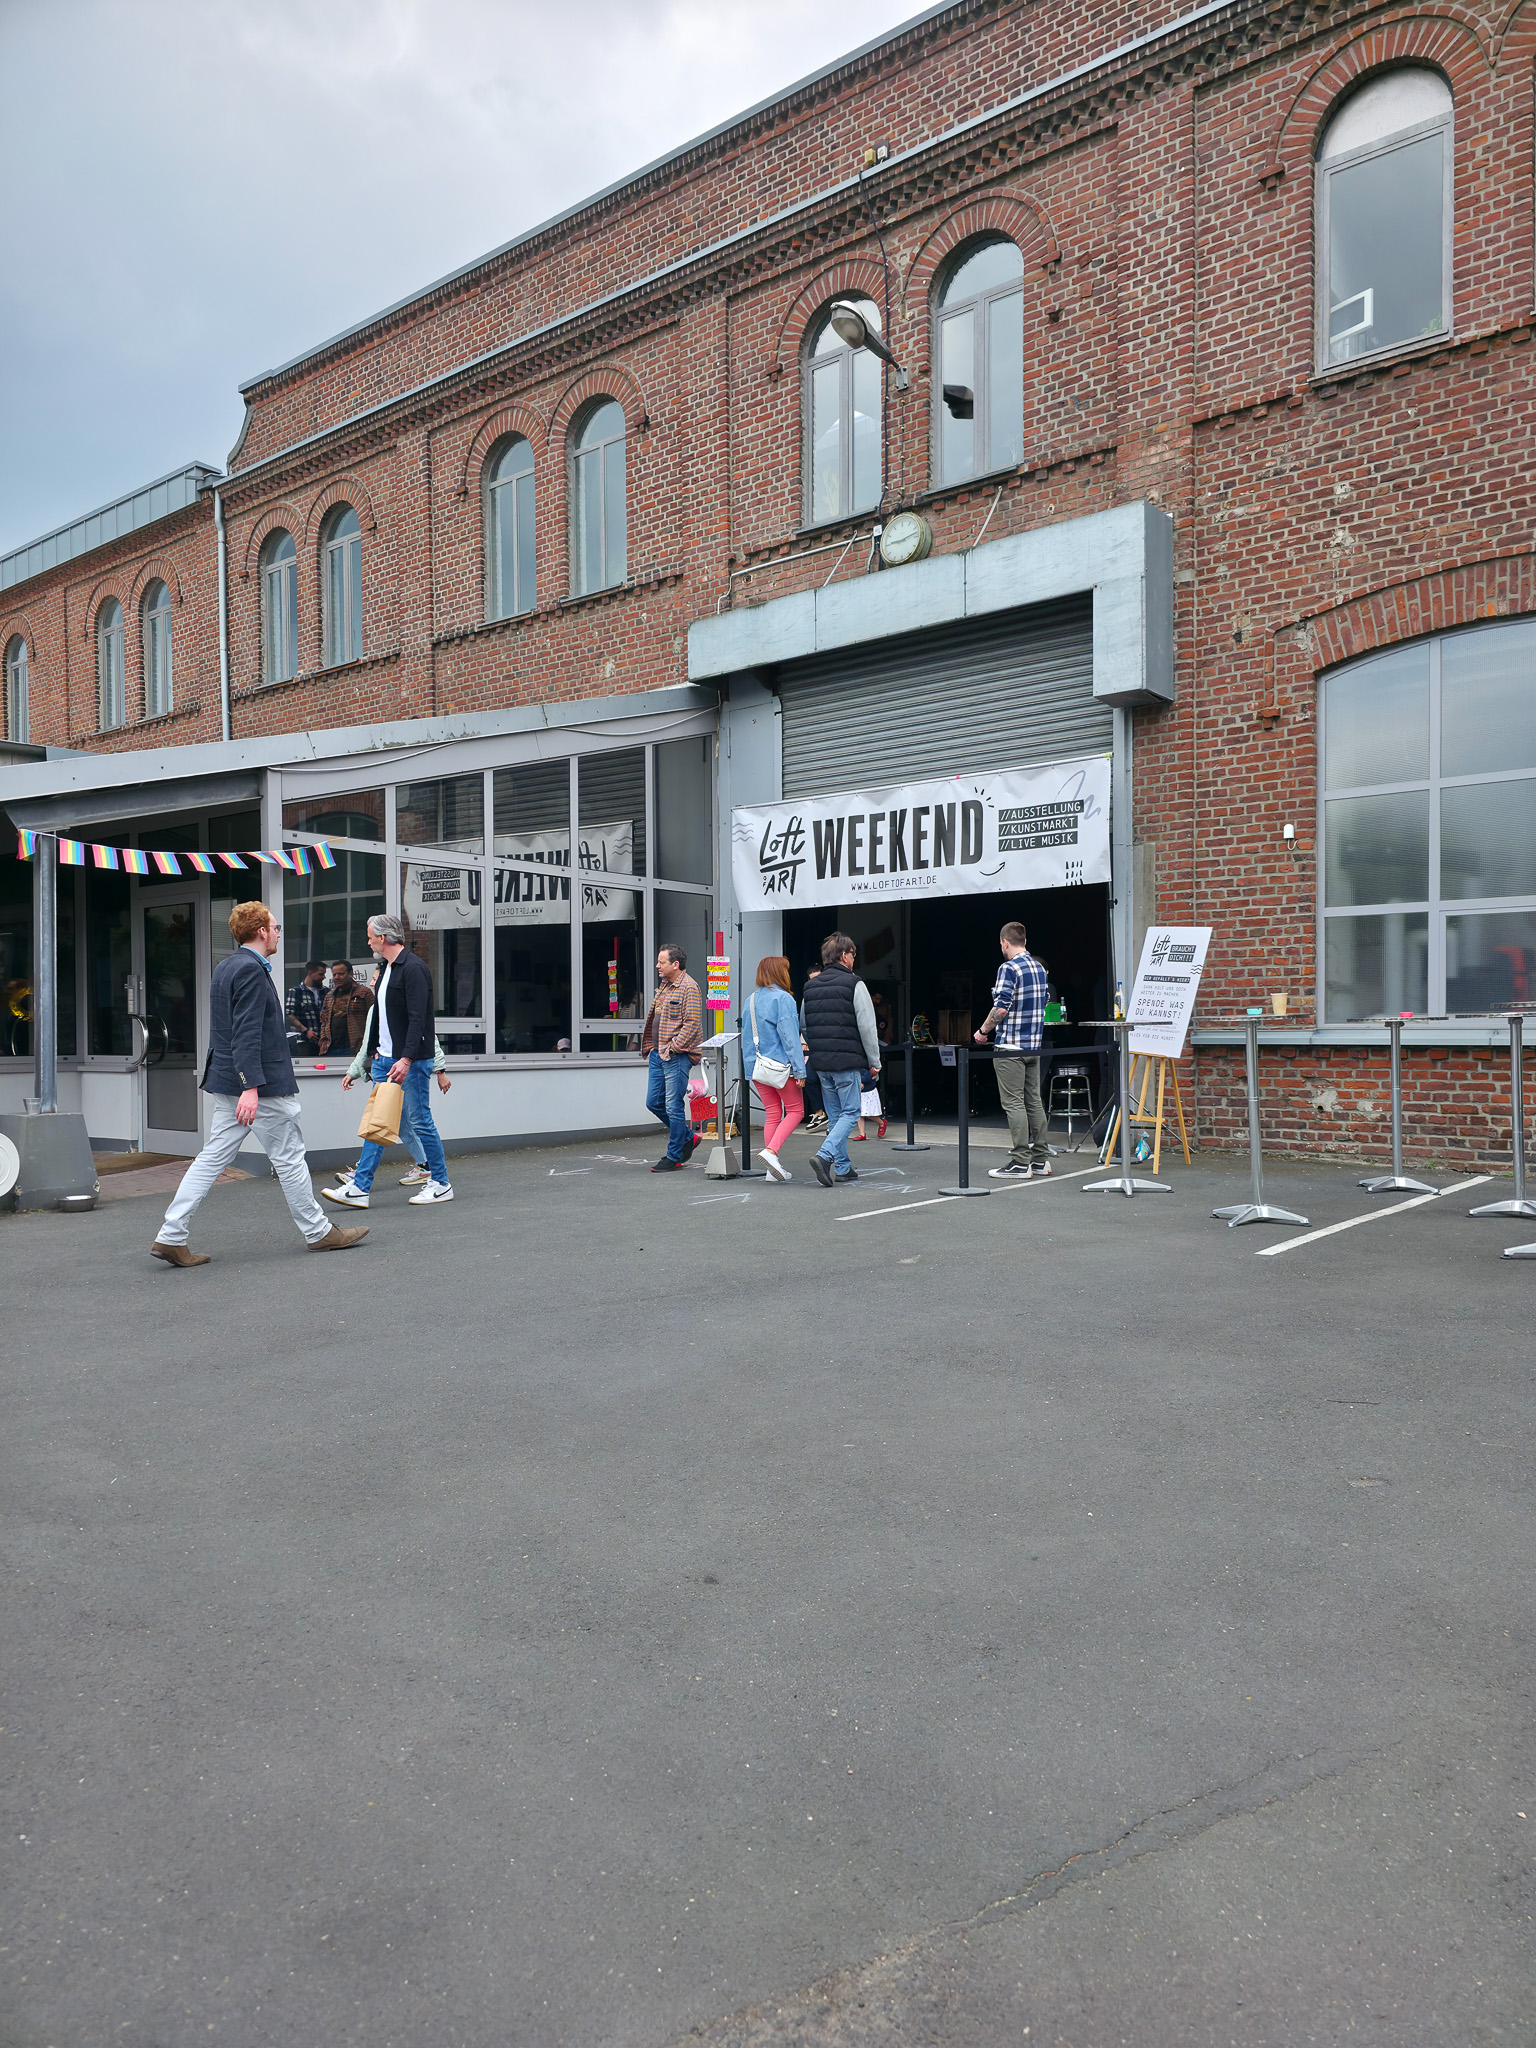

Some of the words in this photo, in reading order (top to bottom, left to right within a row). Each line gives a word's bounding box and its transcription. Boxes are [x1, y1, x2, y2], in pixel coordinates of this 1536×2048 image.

[813, 800, 984, 880] WEEKEND
[1041, 833, 1073, 846] MUSIK
[762, 863, 801, 896] ART
[851, 875, 937, 892] WWW.LOFTOFART.DE
[1137, 998, 1165, 1008] SPENDE
[1169, 1001, 1185, 1010] WAS
[1135, 1008, 1145, 1016] DU
[1148, 1009, 1182, 1019] KANNST!
